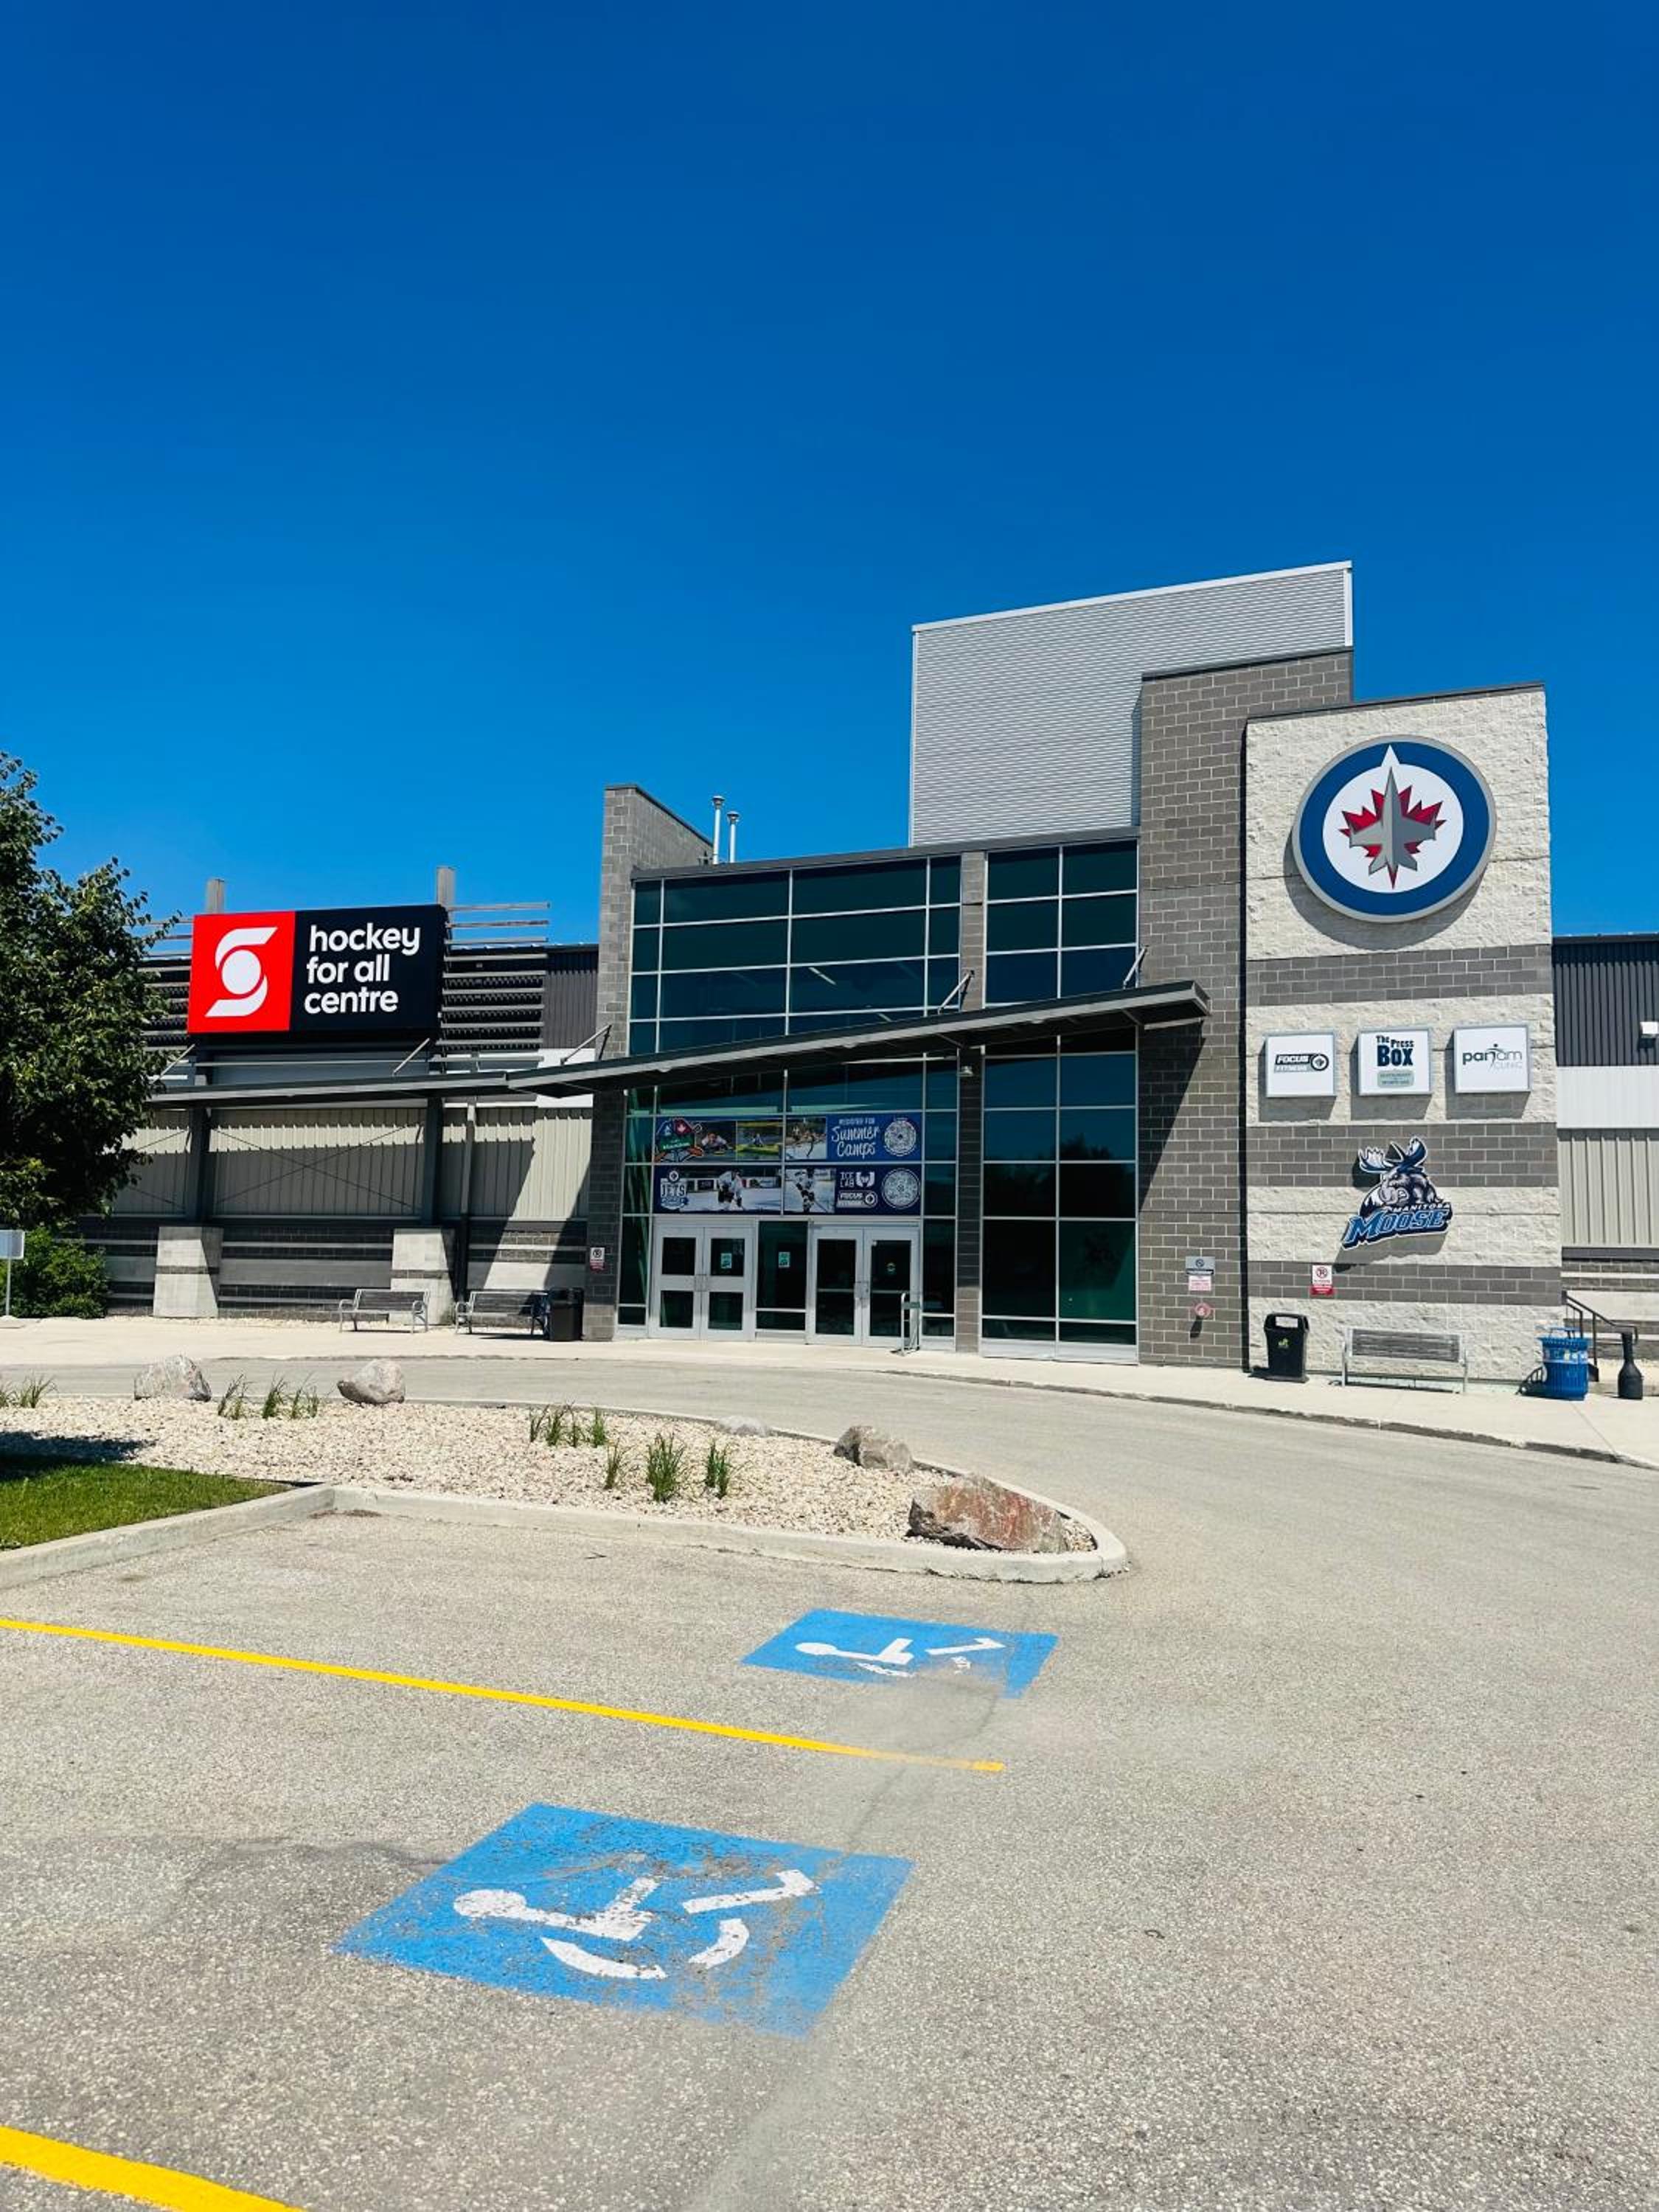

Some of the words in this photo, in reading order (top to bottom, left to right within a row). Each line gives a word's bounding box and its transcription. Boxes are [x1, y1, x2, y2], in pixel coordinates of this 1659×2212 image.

[309, 922, 421, 956] hockey
[306, 956, 349, 984] for
[353, 953, 390, 983] all
[304, 986, 399, 1014] centre
[1376, 1034, 1390, 1043] The
[1391, 1039, 1415, 1048] Press
[1276, 1055, 1310, 1064] FOCUS
[832, 1126, 880, 1142] Summer
[837, 1141, 876, 1159] Camps
[661, 1184, 685, 1197] JETS
[1392, 1203, 1450, 1213] MANITOBA
[1342, 1209, 1450, 1244] MOOSE
